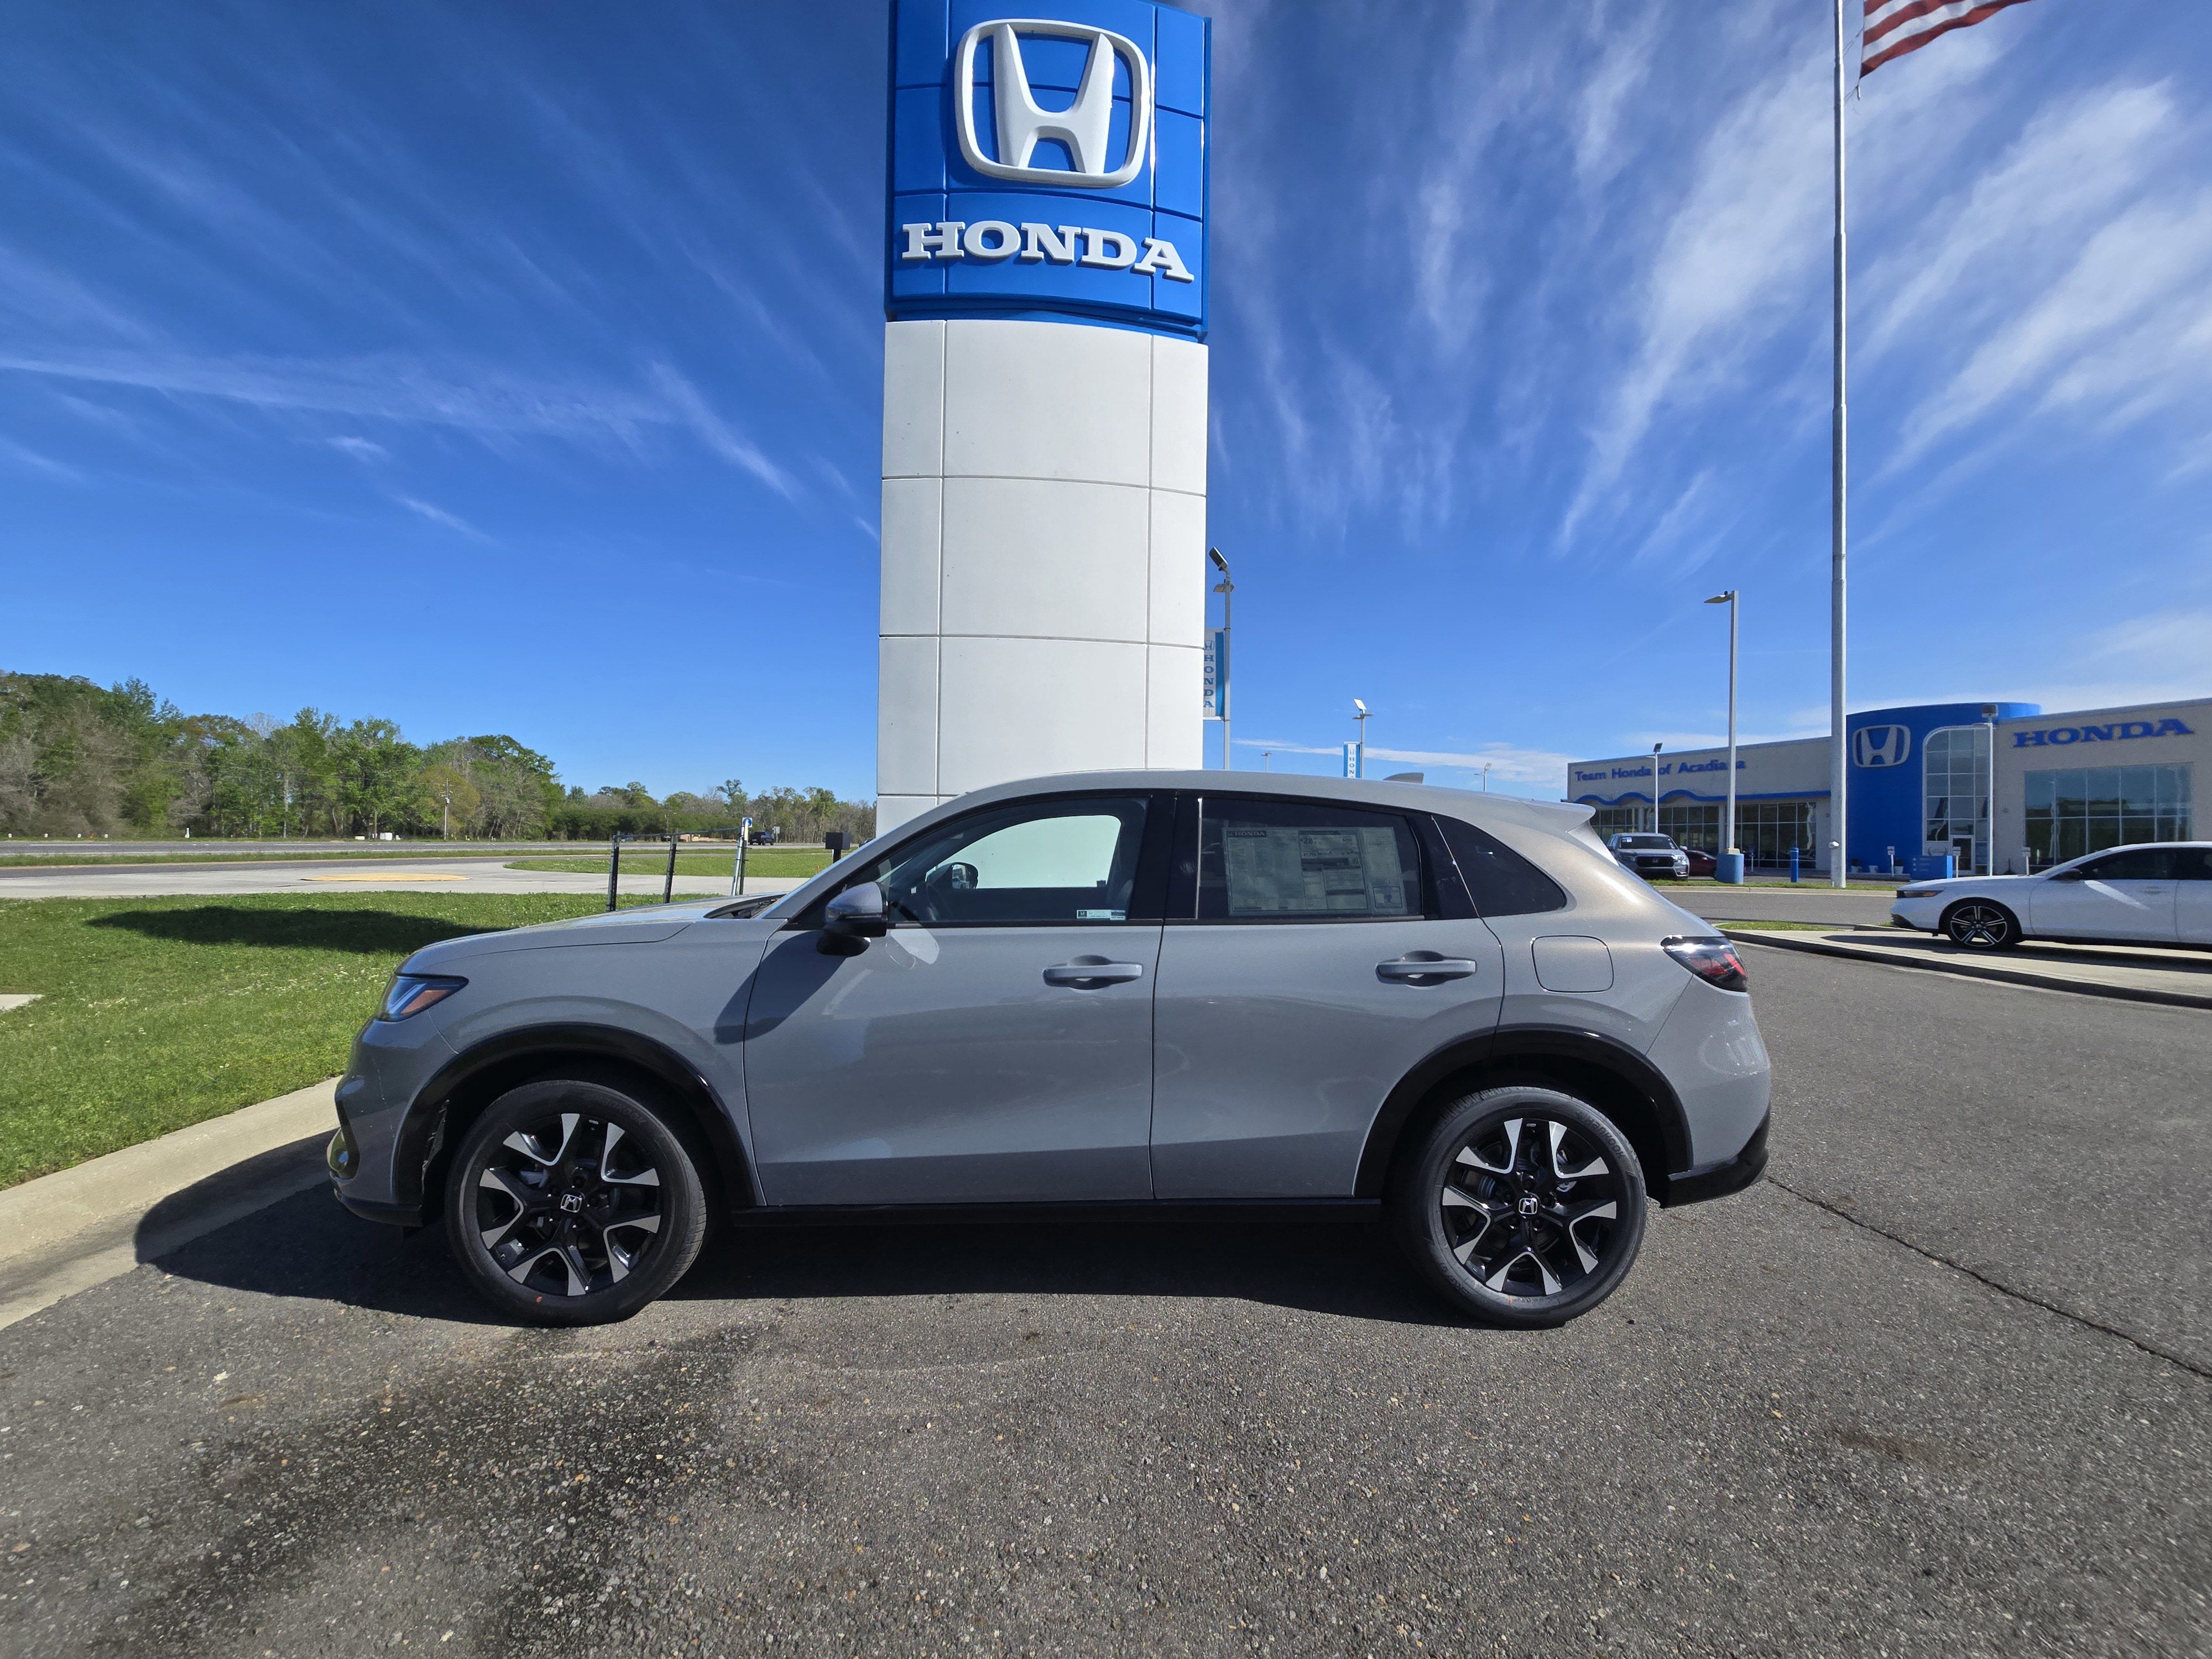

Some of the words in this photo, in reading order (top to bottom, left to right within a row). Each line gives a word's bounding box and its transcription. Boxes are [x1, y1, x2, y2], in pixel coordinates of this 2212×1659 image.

[902, 221, 1194, 282] HONDA
[1203, 655, 1214, 708] HONDA
[2013, 718, 2194, 747] HONDA
[1575, 771, 1606, 781] Team
[1611, 765, 1652, 779] Honda
[1658, 764, 1672, 775] of
[1678, 759, 1746, 774] Acadiaa
